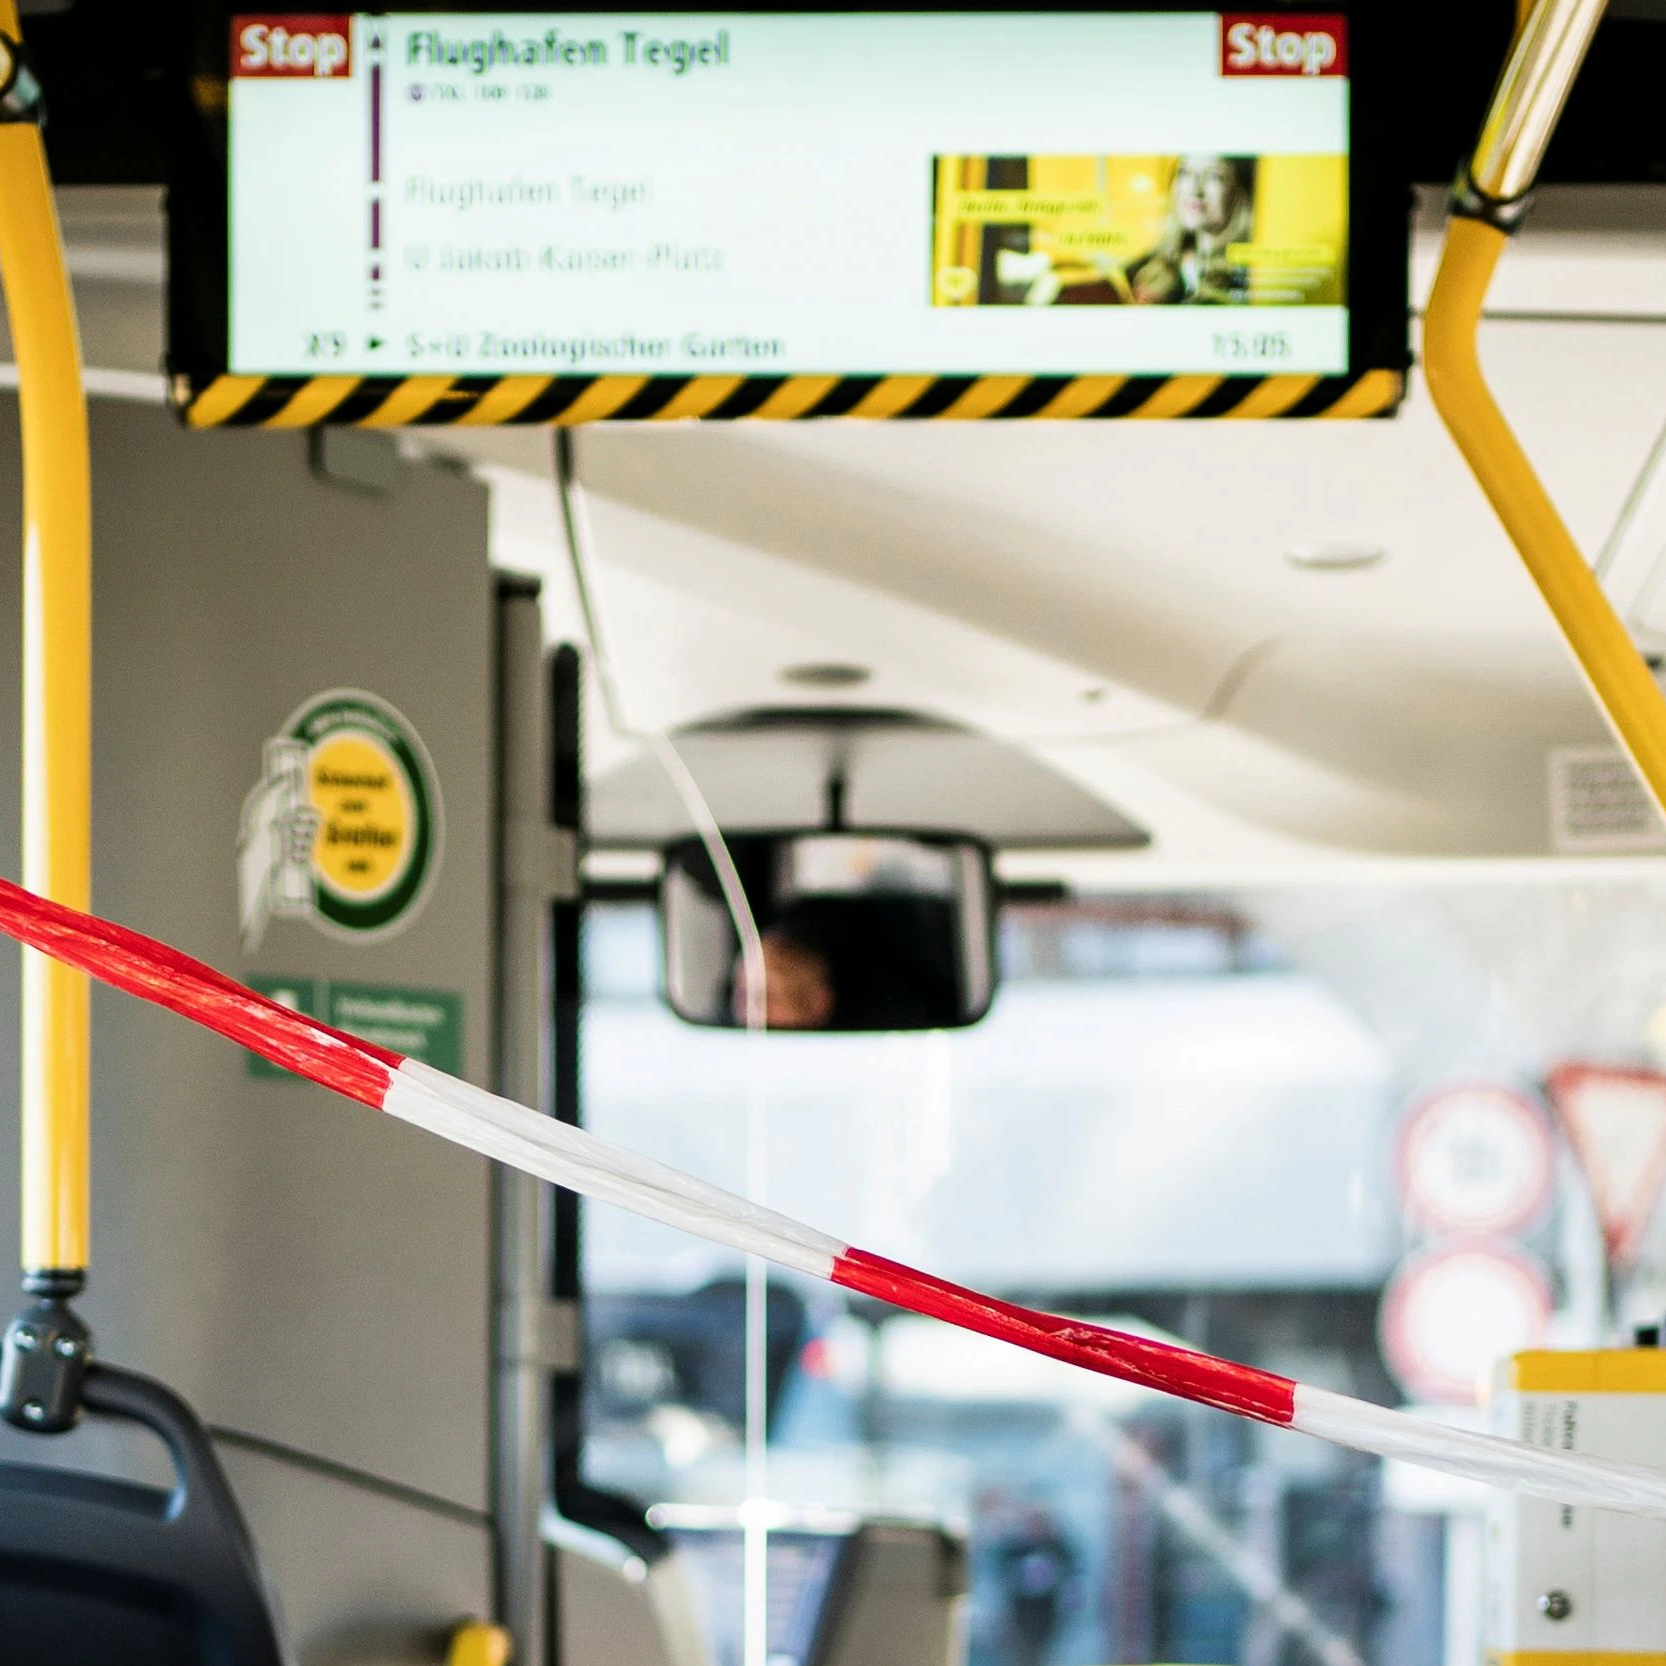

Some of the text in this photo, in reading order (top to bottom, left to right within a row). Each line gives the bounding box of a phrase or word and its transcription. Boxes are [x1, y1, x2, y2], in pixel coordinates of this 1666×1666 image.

[240, 24, 348, 76] Stop
[406, 29, 729, 74] Flughafen Tegel
[1227, 22, 1337, 76] Stop
[406, 176, 650, 211] Flughafen Tegel
[479, 331, 668, 364] Zoologischer
[682, 331, 784, 358] Garten
